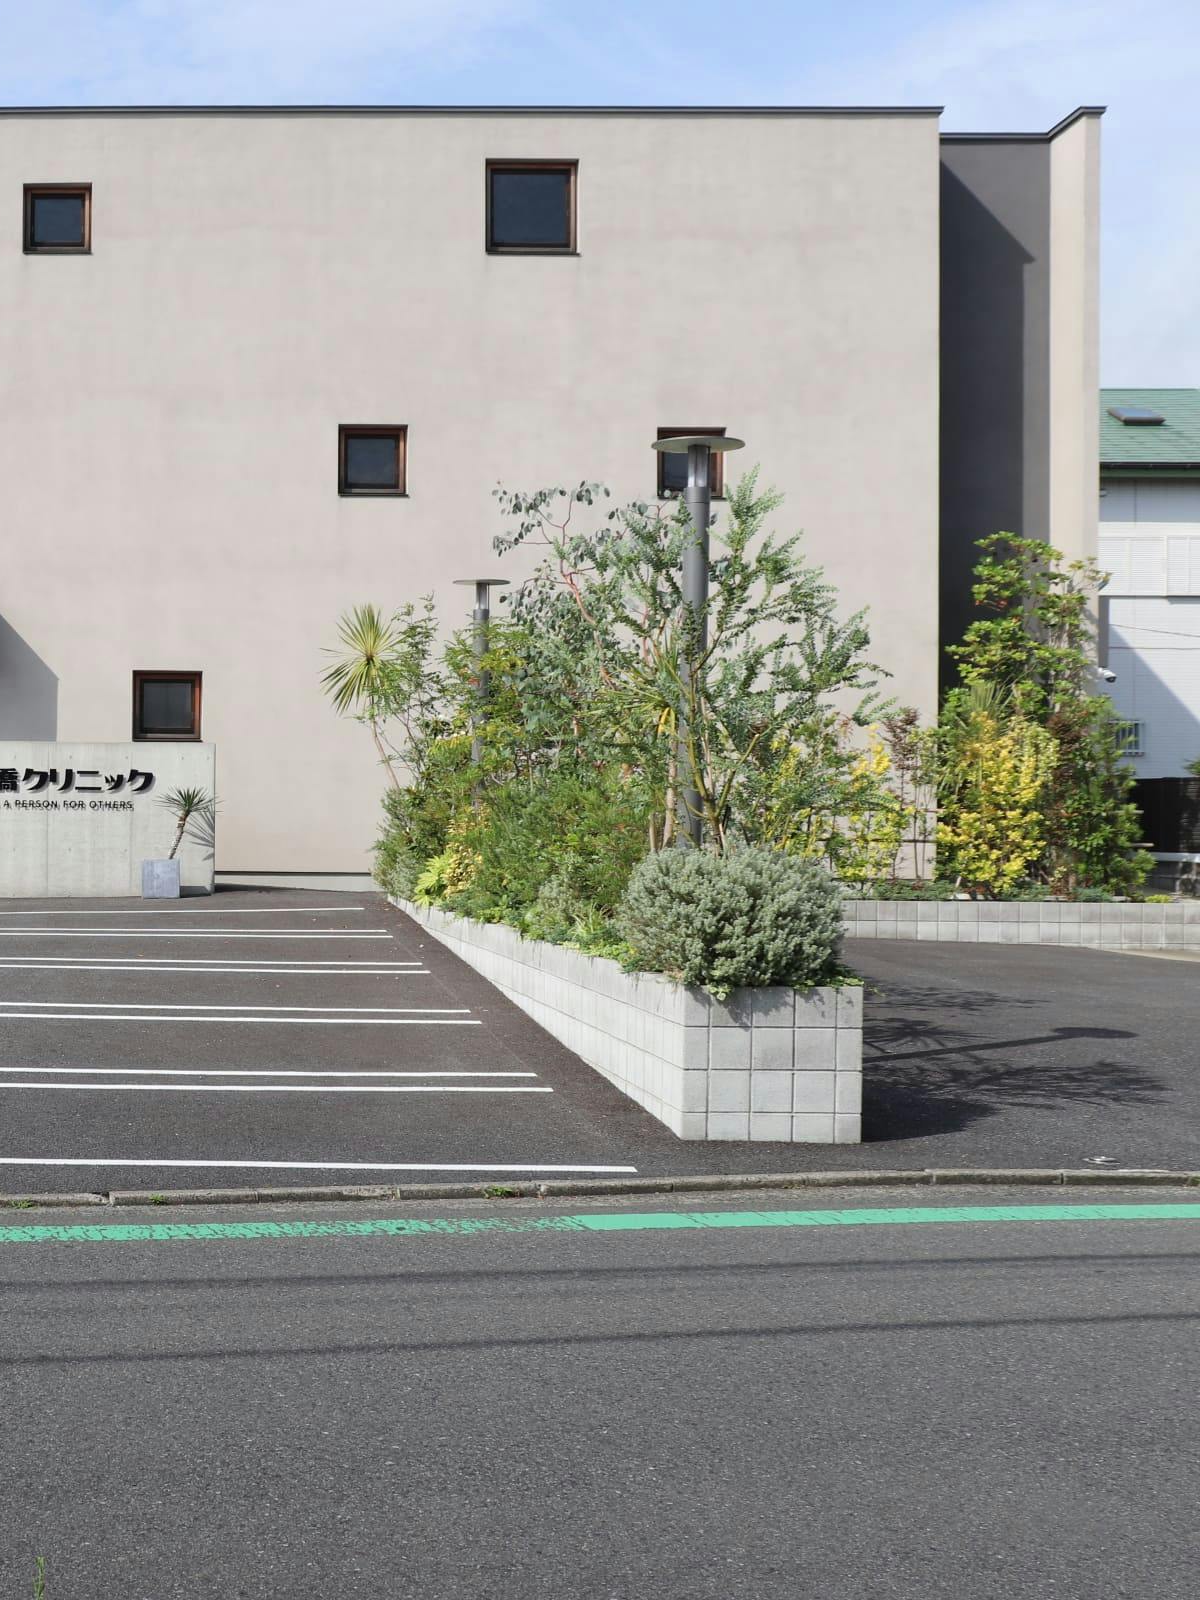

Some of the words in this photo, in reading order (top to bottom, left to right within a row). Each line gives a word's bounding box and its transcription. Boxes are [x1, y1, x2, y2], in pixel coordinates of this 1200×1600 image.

[3, 799, 10, 808] A
[15, 799, 58, 809] PERSON
[63, 800, 84, 809] FOR
[89, 800, 133, 809] OTHERS
